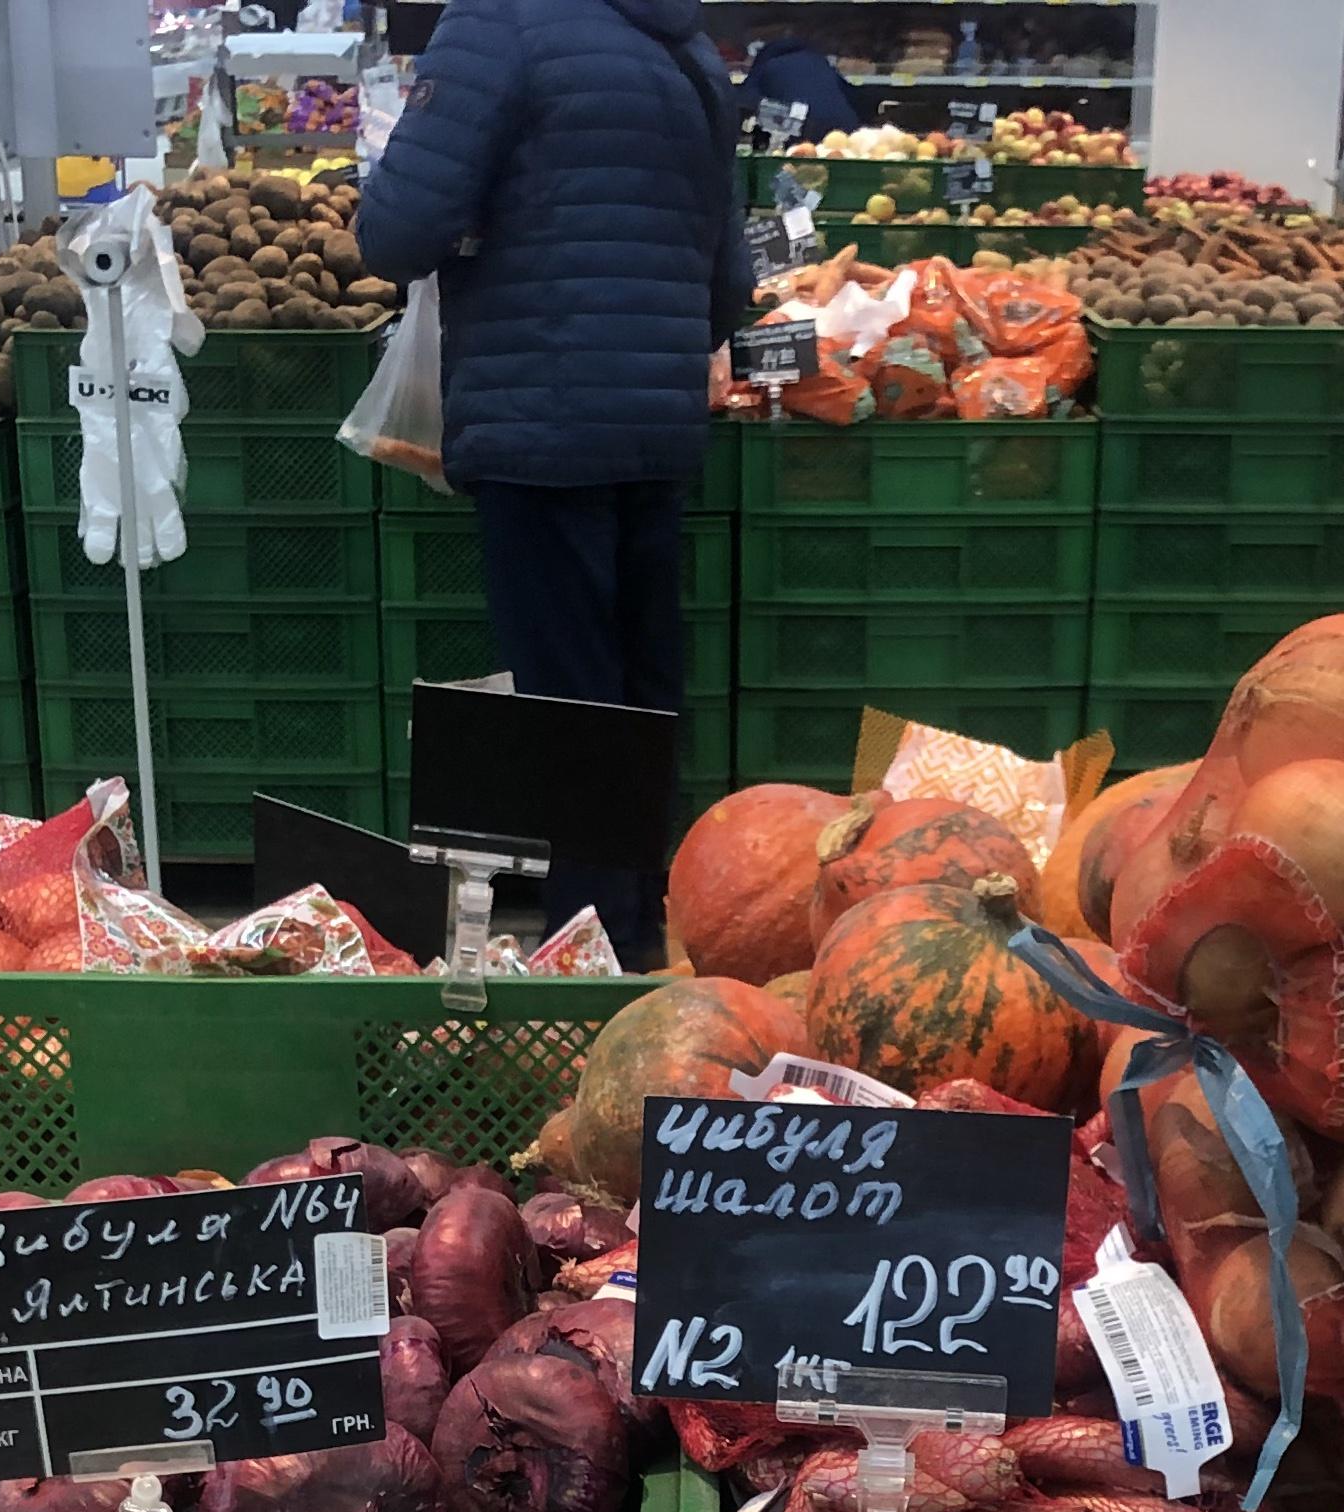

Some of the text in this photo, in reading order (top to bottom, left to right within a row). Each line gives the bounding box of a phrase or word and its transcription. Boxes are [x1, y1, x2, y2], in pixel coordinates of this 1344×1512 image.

[844, 1254, 1058, 1354] 122 90
[164, 1375, 312, 1439] 32 90
[332, 1416, 375, 1434] ГРН.
